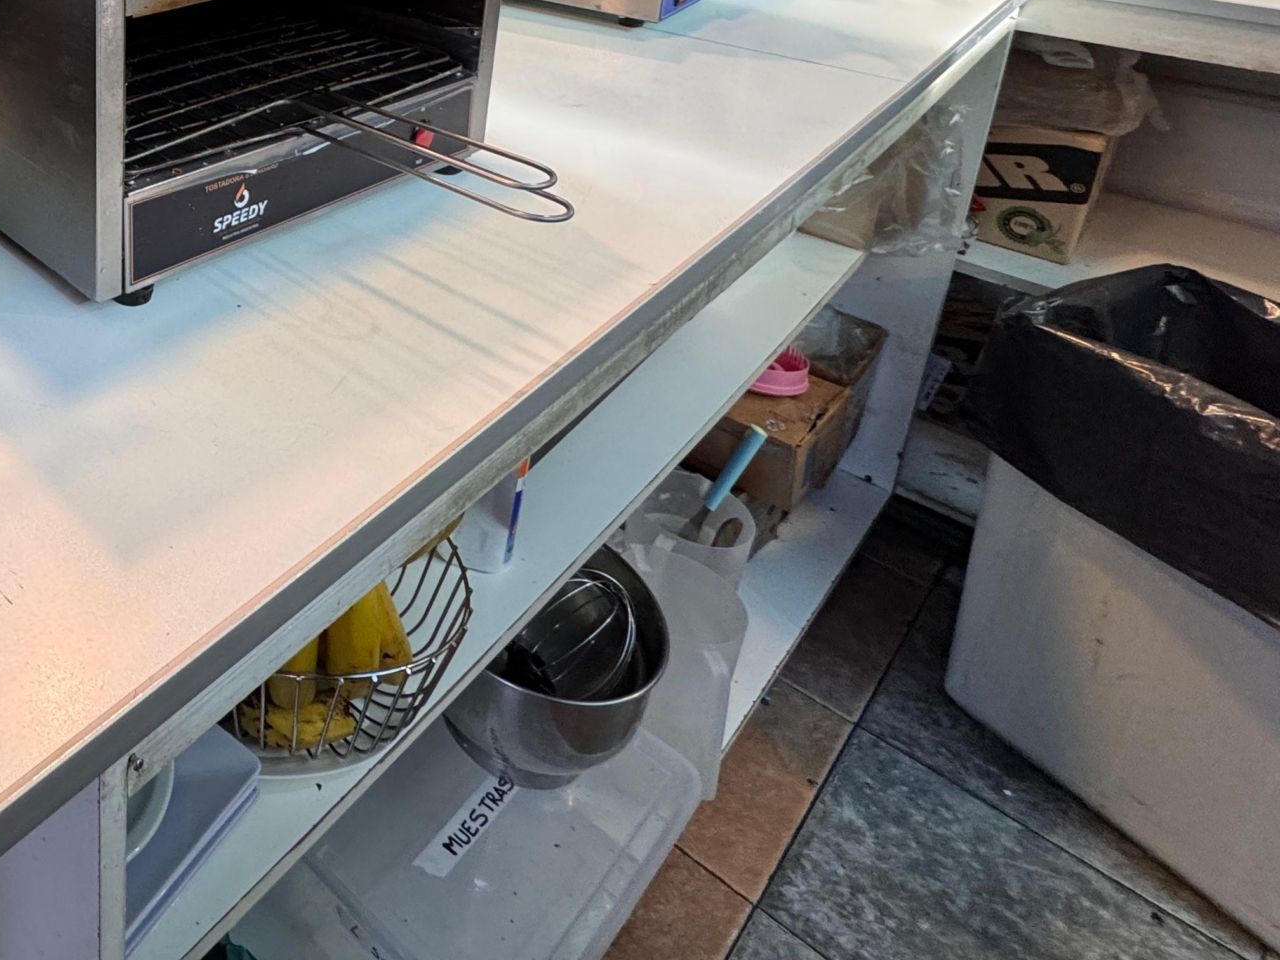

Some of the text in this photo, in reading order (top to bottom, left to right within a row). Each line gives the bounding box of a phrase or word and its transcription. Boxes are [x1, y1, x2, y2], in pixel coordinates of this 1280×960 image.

[205, 174, 245, 193] TOSTADORA
[213, 199, 268, 233] SPEEDY
[442, 774, 515, 856] MUESTRAS
